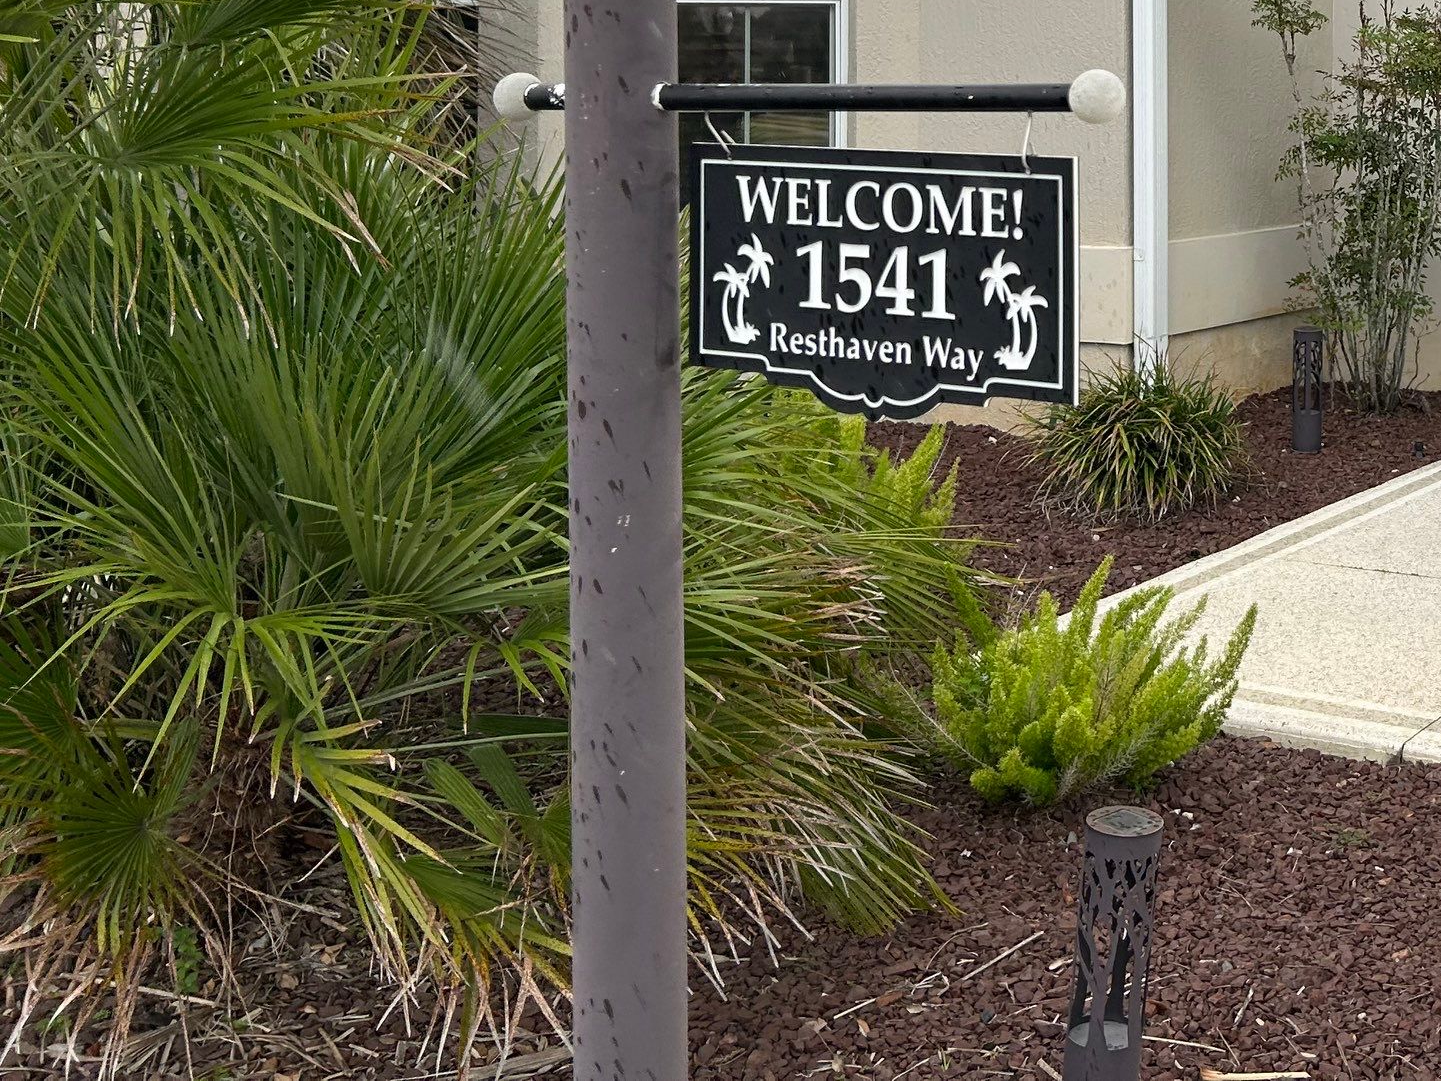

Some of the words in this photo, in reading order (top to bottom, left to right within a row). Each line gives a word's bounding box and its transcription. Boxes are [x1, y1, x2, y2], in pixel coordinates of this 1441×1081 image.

[735, 174, 1024, 241] WELCOME!
[796, 240, 956, 321] 1541
[769, 322, 912, 365] Resthaven
[922, 335, 985, 382] Way
